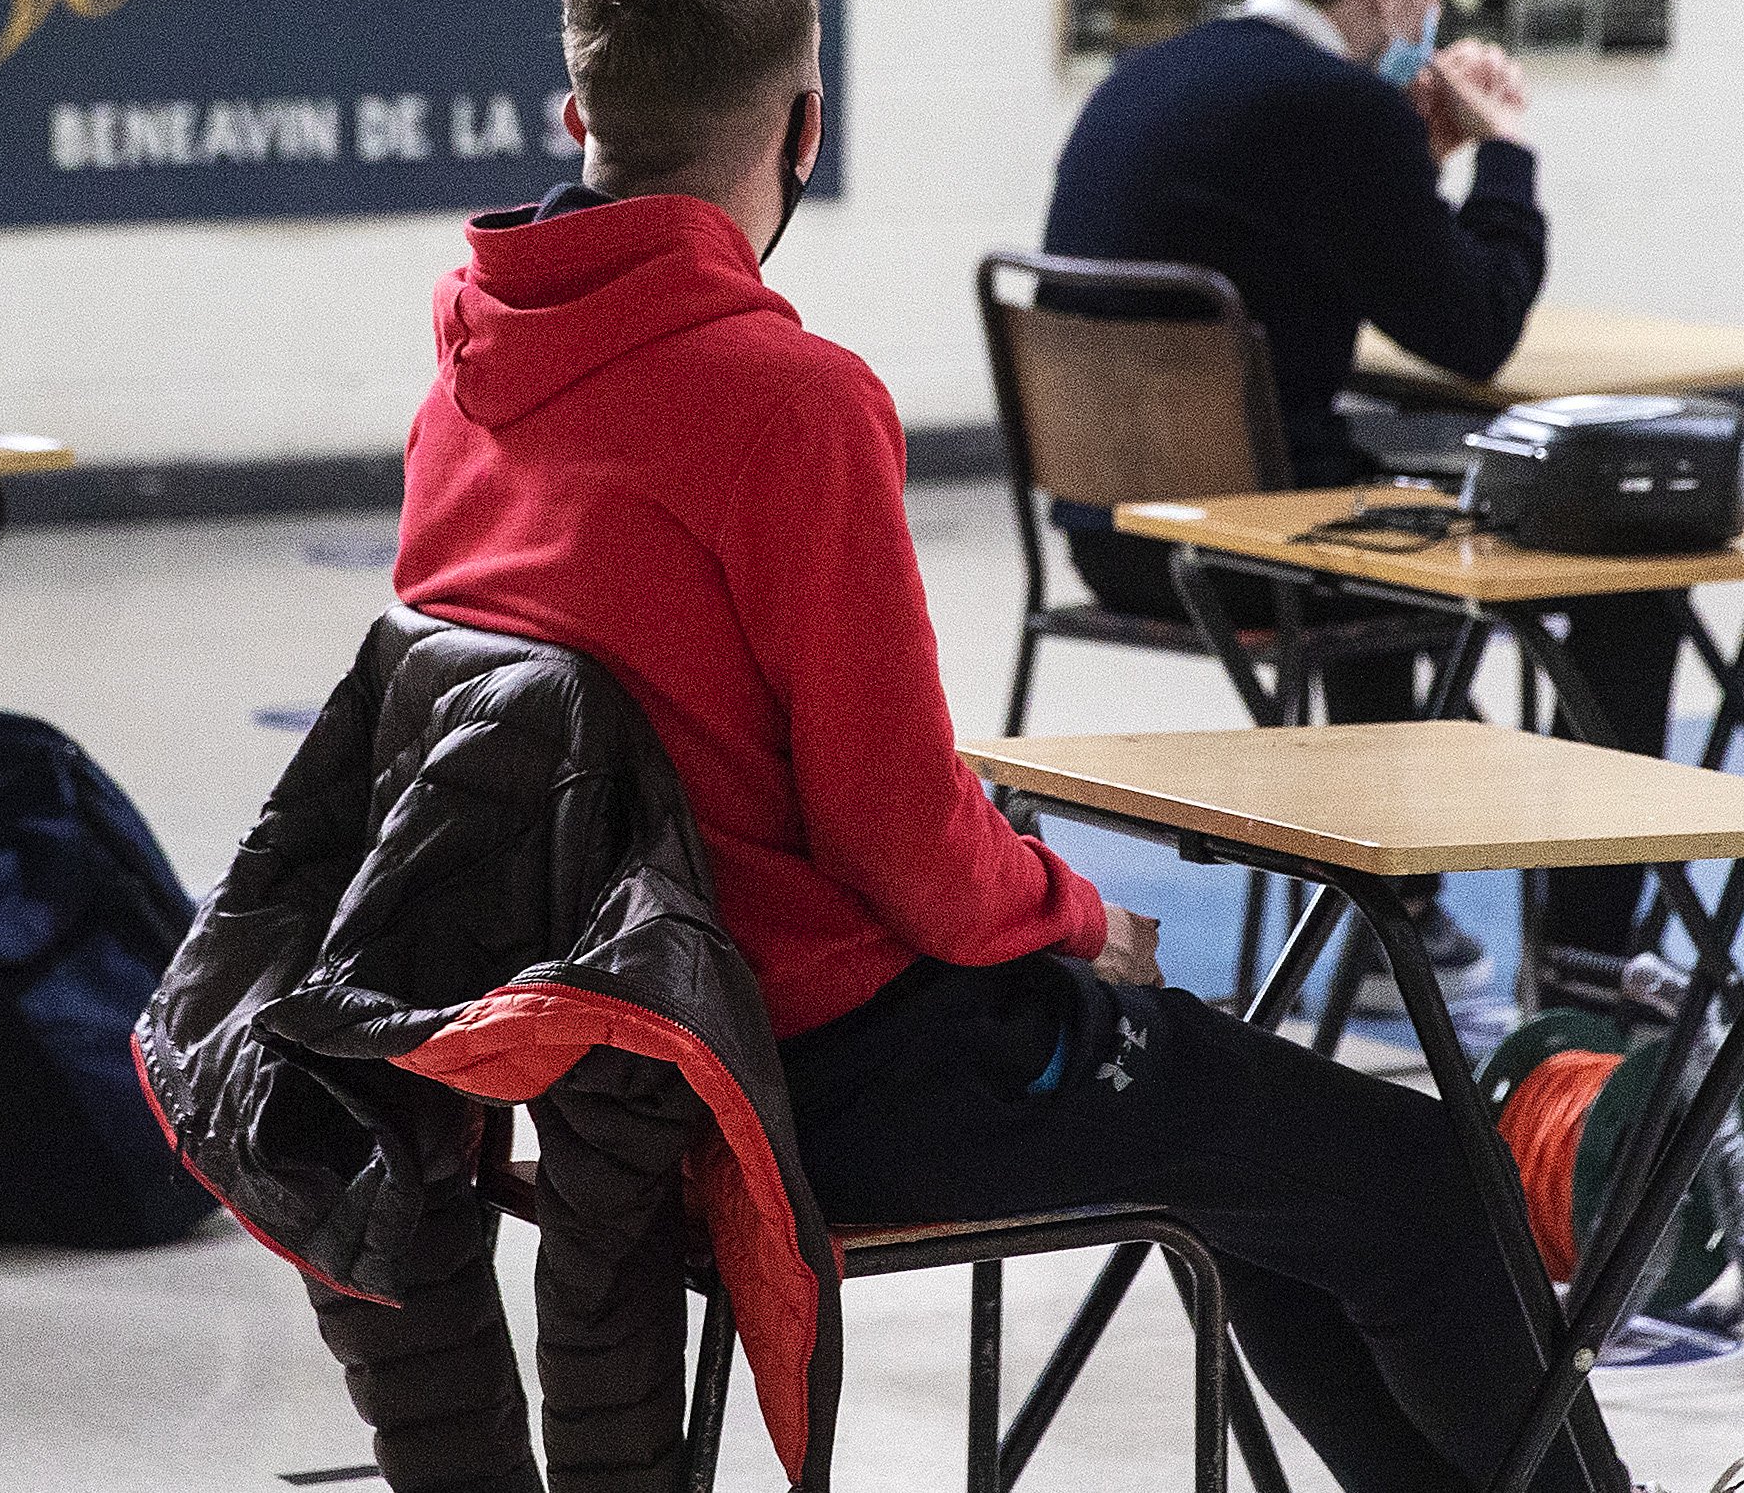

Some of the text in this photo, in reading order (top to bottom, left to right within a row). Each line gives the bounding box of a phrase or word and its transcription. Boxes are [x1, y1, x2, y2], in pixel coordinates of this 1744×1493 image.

[52, 97, 340, 170] BENEAVIN
[358, 94, 428, 163] DE
[451, 91, 524, 159] LA
